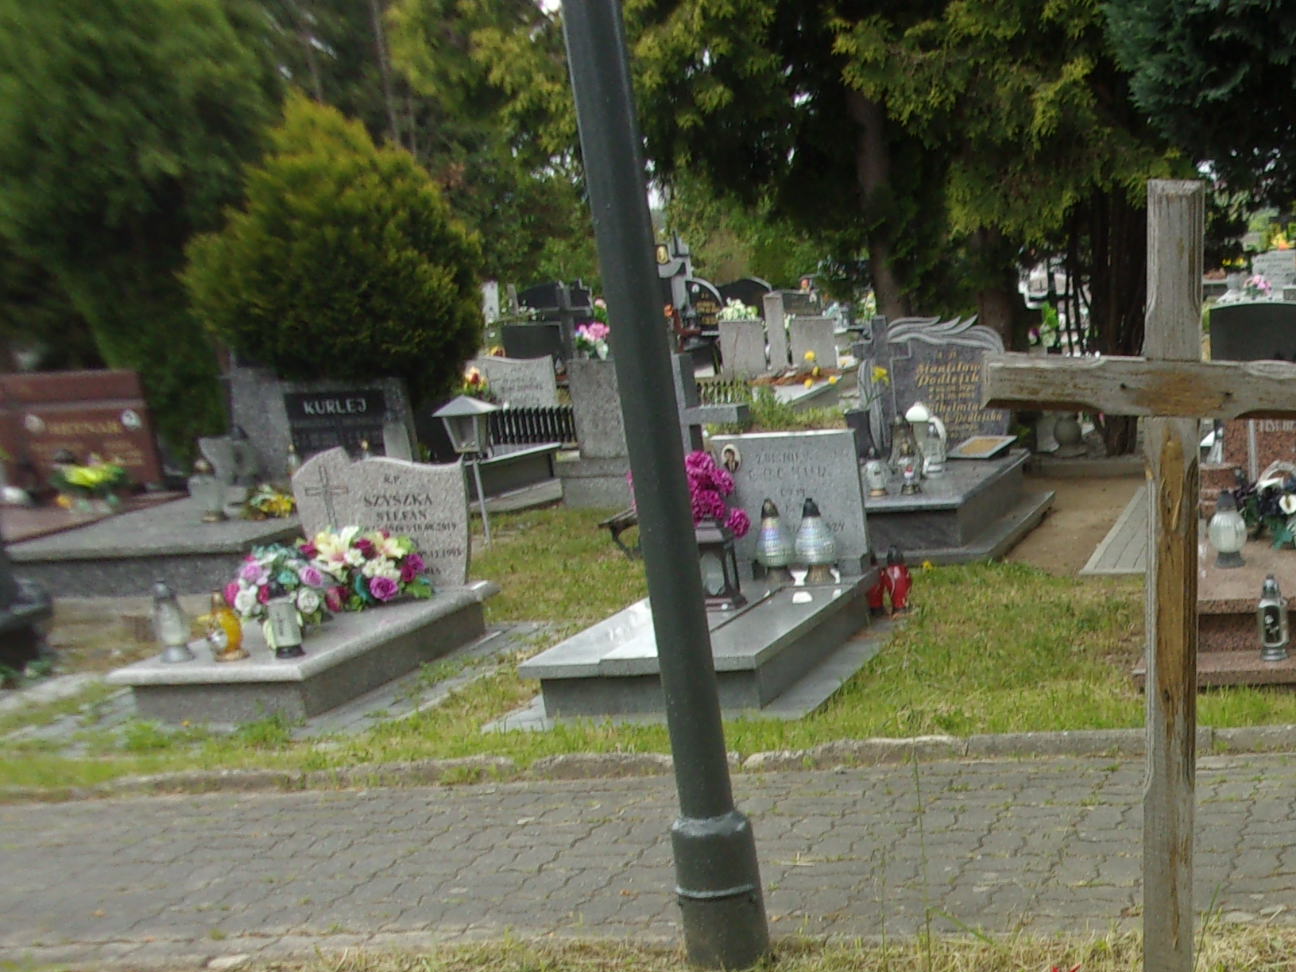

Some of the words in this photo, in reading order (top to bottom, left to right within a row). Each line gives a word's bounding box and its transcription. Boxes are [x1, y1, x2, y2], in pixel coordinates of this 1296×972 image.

[303, 397, 367, 415] KURLEJ
[363, 492, 433, 508] SZYSZKA
[376, 508, 428, 523] STEFAN
